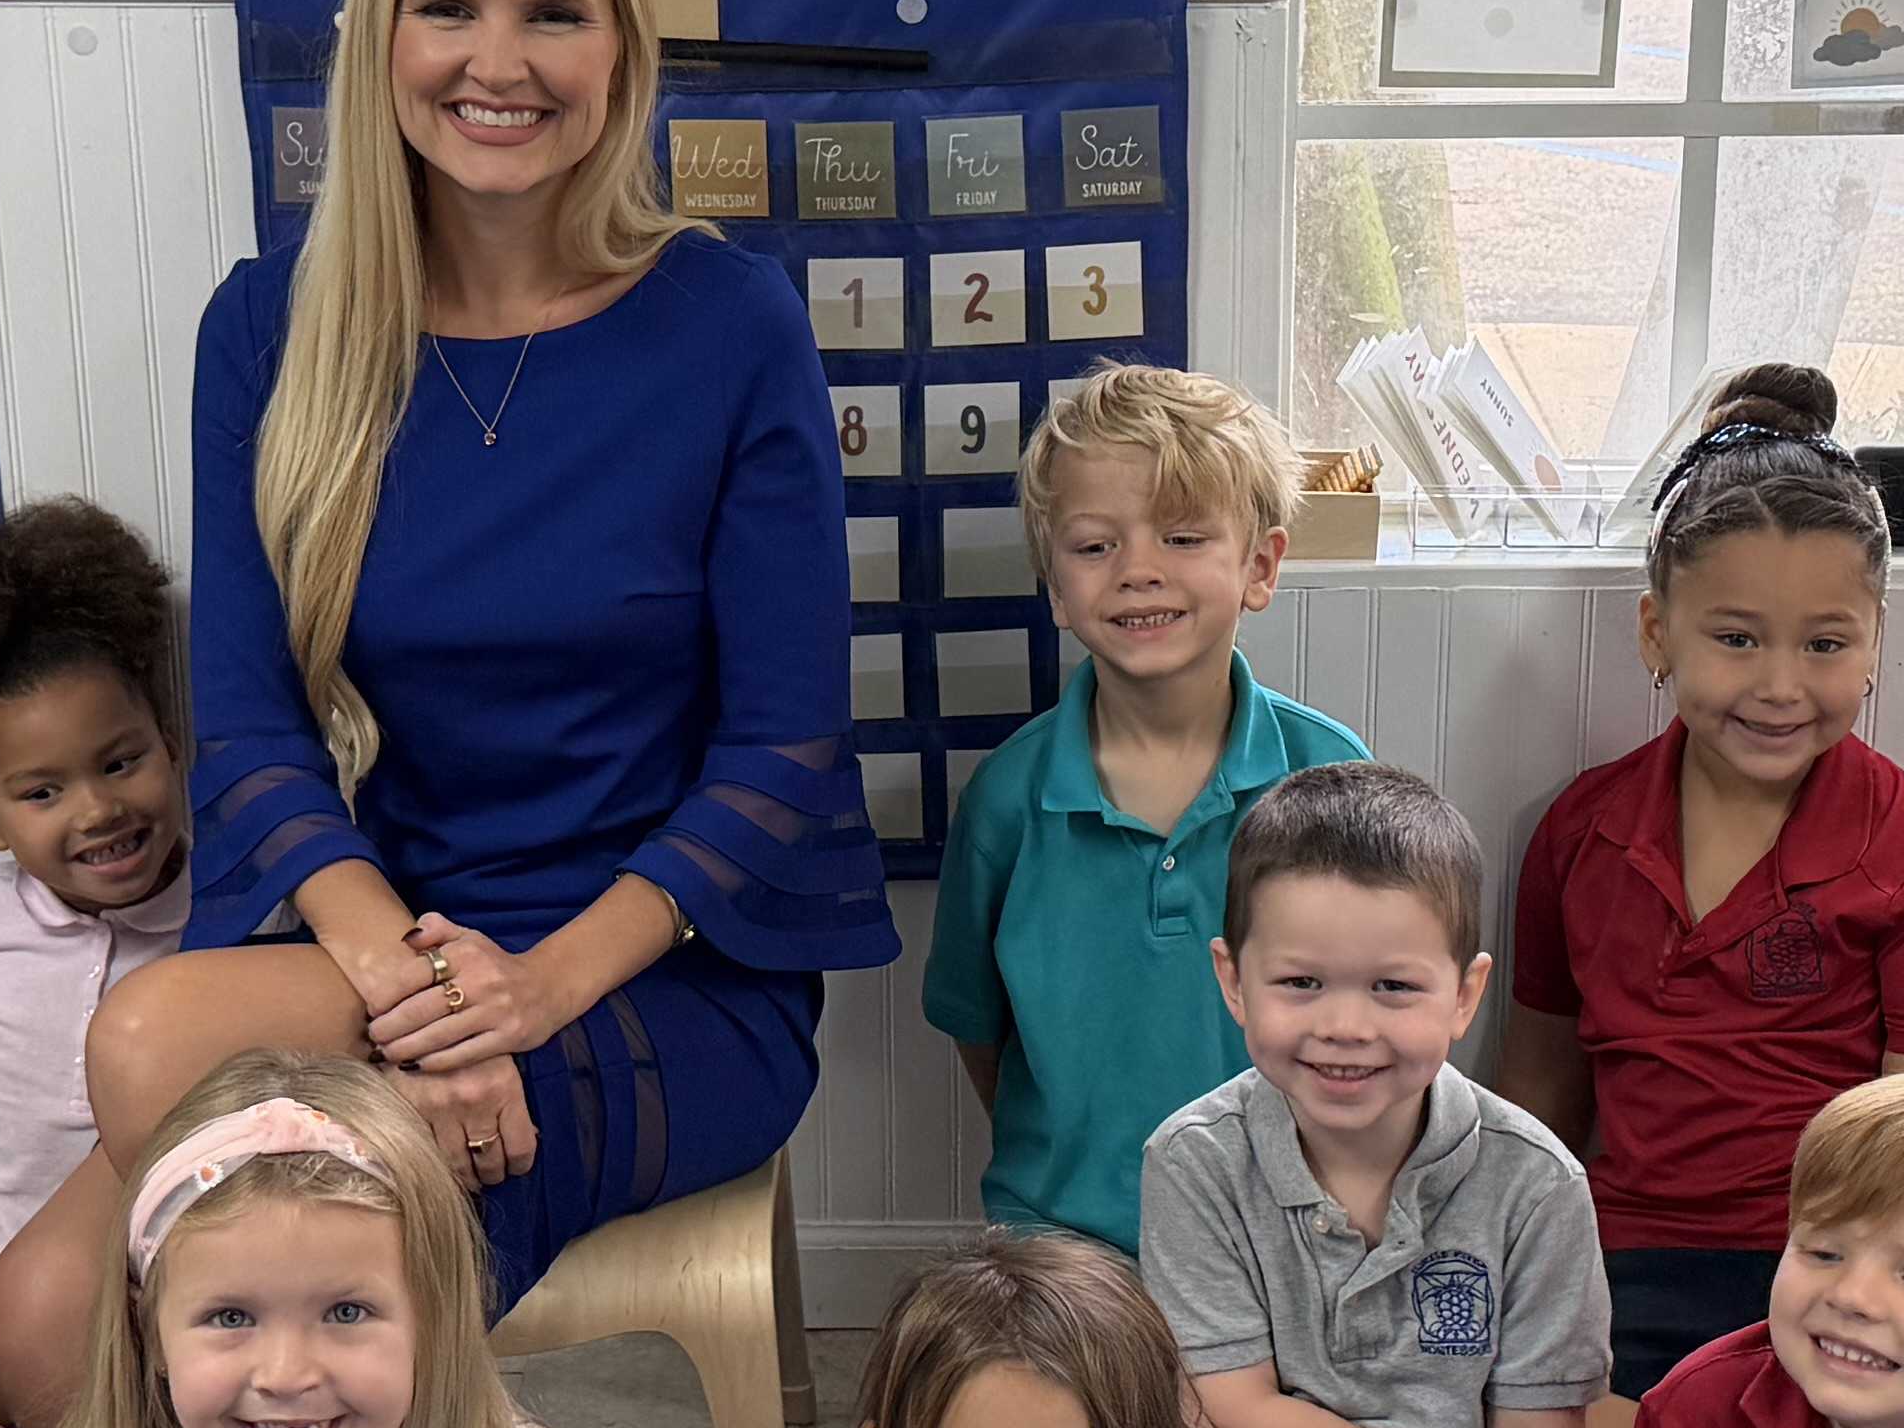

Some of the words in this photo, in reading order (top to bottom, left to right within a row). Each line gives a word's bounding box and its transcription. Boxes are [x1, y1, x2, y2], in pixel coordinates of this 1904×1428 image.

[280, 121, 327, 166] Su
[685, 193, 758, 209] WEDNESDAY
[815, 196, 876, 211] THURSDAY
[955, 190, 997, 206] FRIDAY
[1081, 180, 1142, 198] SATURDAY
[841, 277, 864, 329] 1
[963, 272, 993, 325] 2
[1082, 265, 1108, 317] 3
[839, 405, 868, 457] 8
[960, 404, 986, 455] 9
